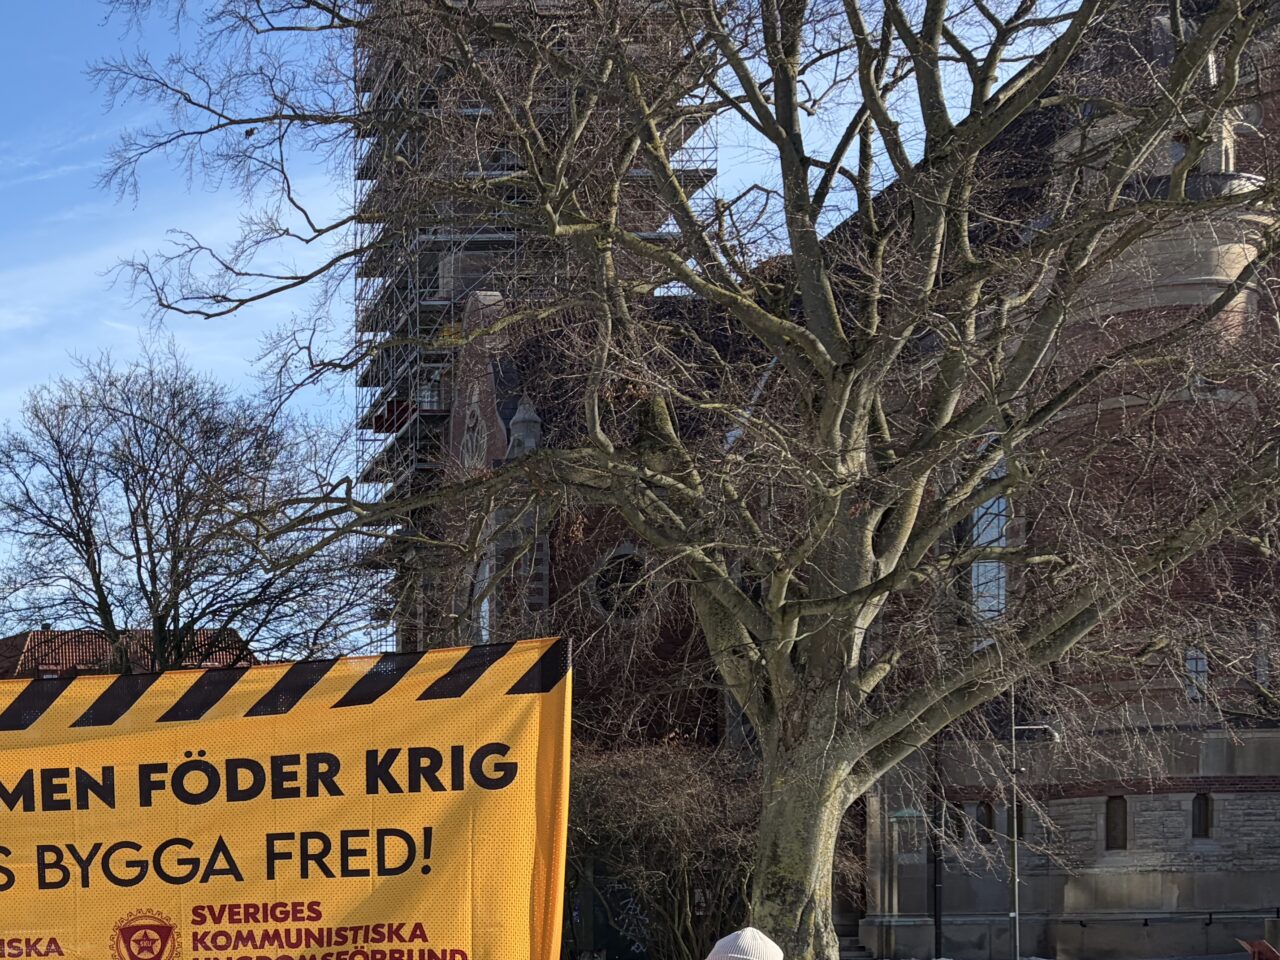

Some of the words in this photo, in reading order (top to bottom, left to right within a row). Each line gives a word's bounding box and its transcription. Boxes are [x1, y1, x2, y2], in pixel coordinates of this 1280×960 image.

[138, 749, 345, 808] FÖDER
[365, 742, 519, 795] KRIG
[36, 835, 245, 890] BYGGA
[265, 827, 434, 881] FRED!
[191, 901, 323, 926] SVERIGES
[192, 922, 429, 952] KOMMUNISTISKA
